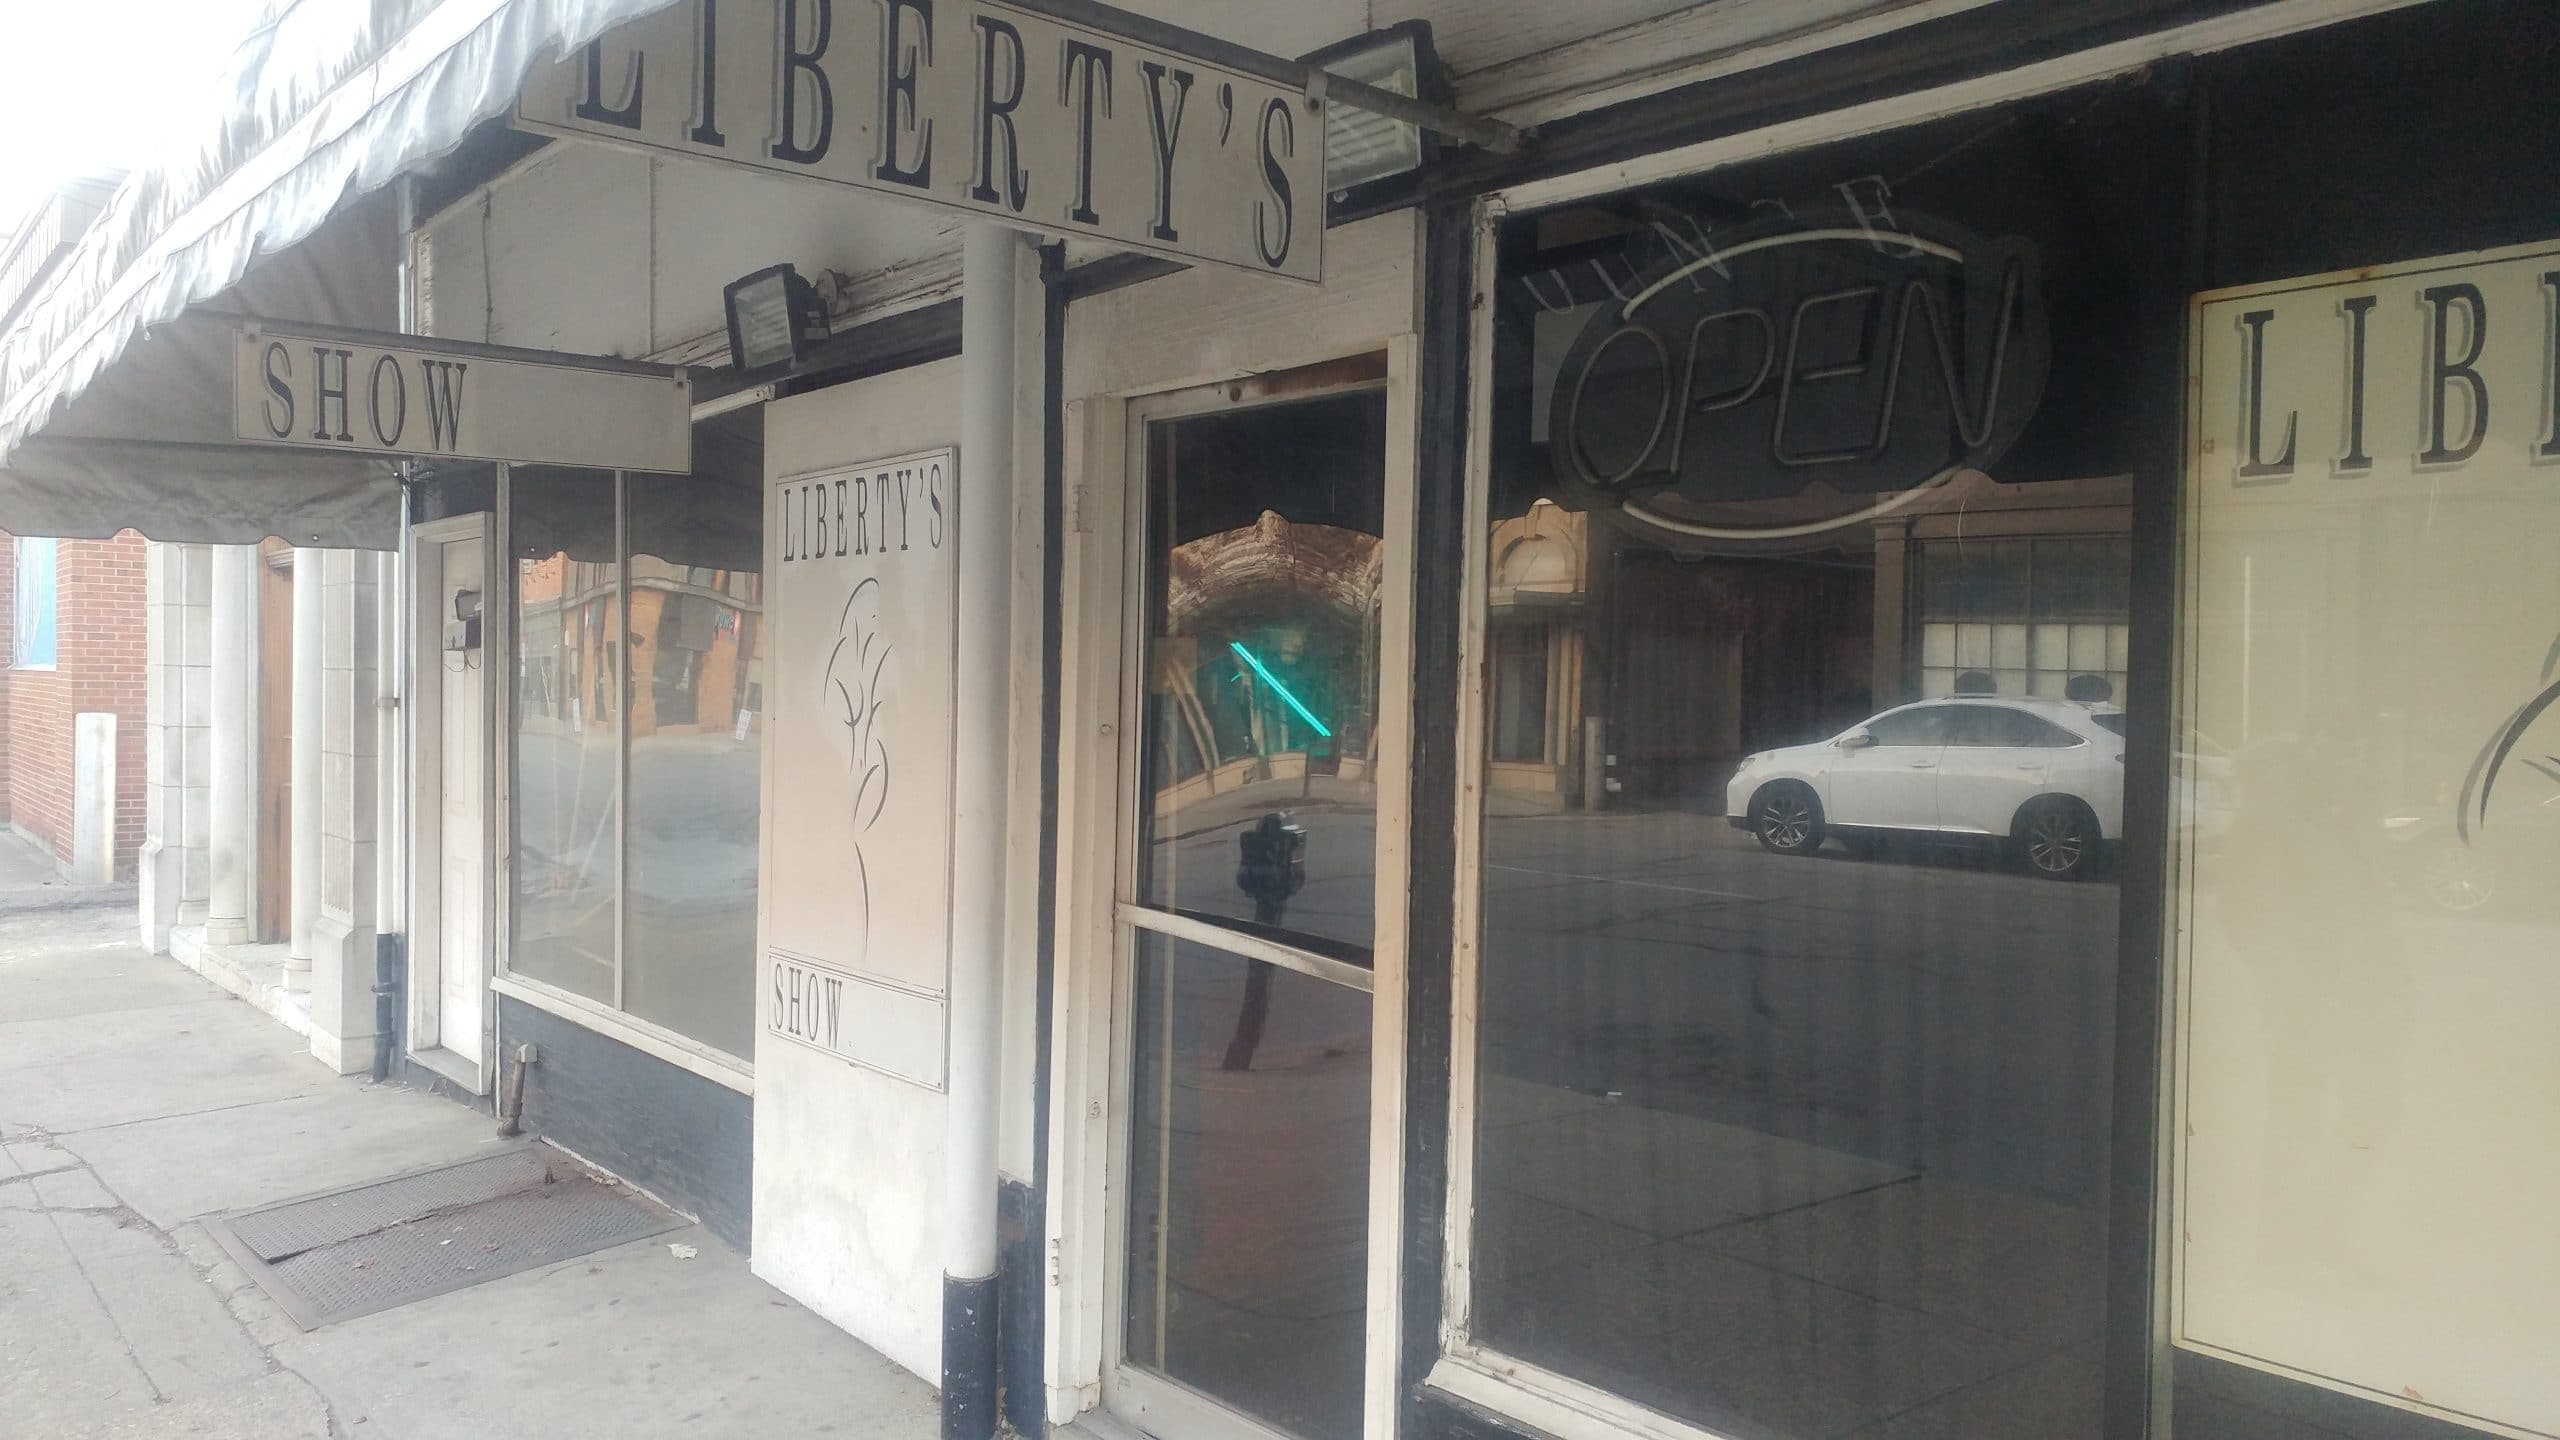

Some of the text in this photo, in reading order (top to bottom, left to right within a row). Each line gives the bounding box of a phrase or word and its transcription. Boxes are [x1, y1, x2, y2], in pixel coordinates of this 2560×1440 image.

[571, 0, 1294, 268] LIBERTY'S
[264, 340, 467, 452] SHOW
[1568, 256, 2023, 486] OPEN
[783, 463, 942, 562] LIBERTY'S
[774, 963, 843, 1050] SHOW
